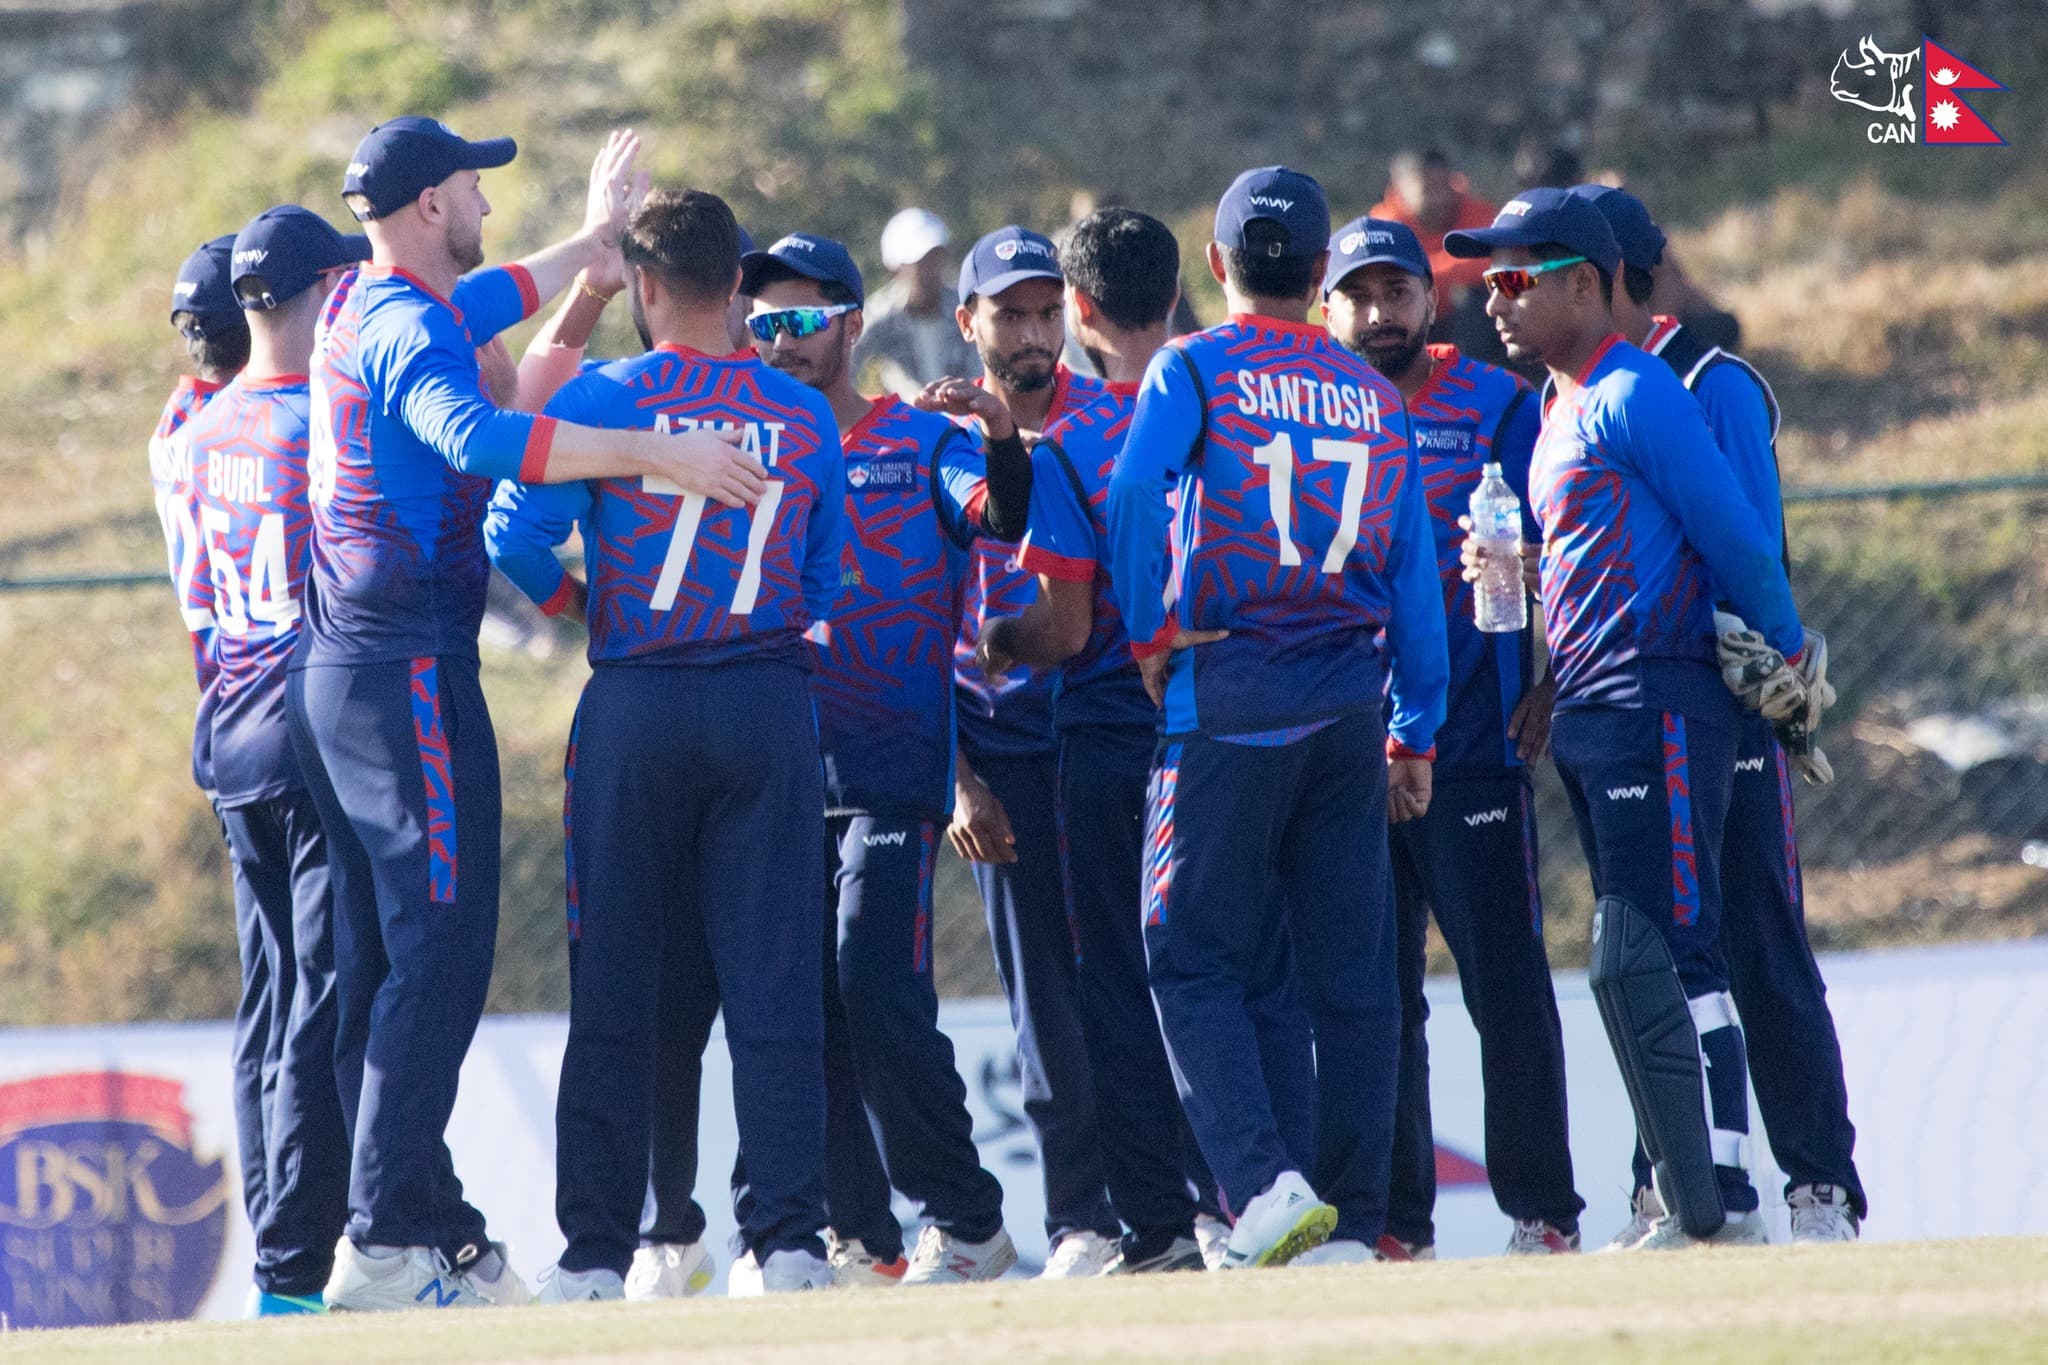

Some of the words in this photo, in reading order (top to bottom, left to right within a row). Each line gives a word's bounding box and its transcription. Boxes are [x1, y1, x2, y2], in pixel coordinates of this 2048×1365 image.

[1237, 368, 1381, 433] SANTOSH
[208, 449, 272, 503] BURL
[1253, 431, 1370, 574] 17
[201, 504, 301, 638] 54
[642, 474, 785, 615] 77
[16, 1140, 163, 1228] BSK
